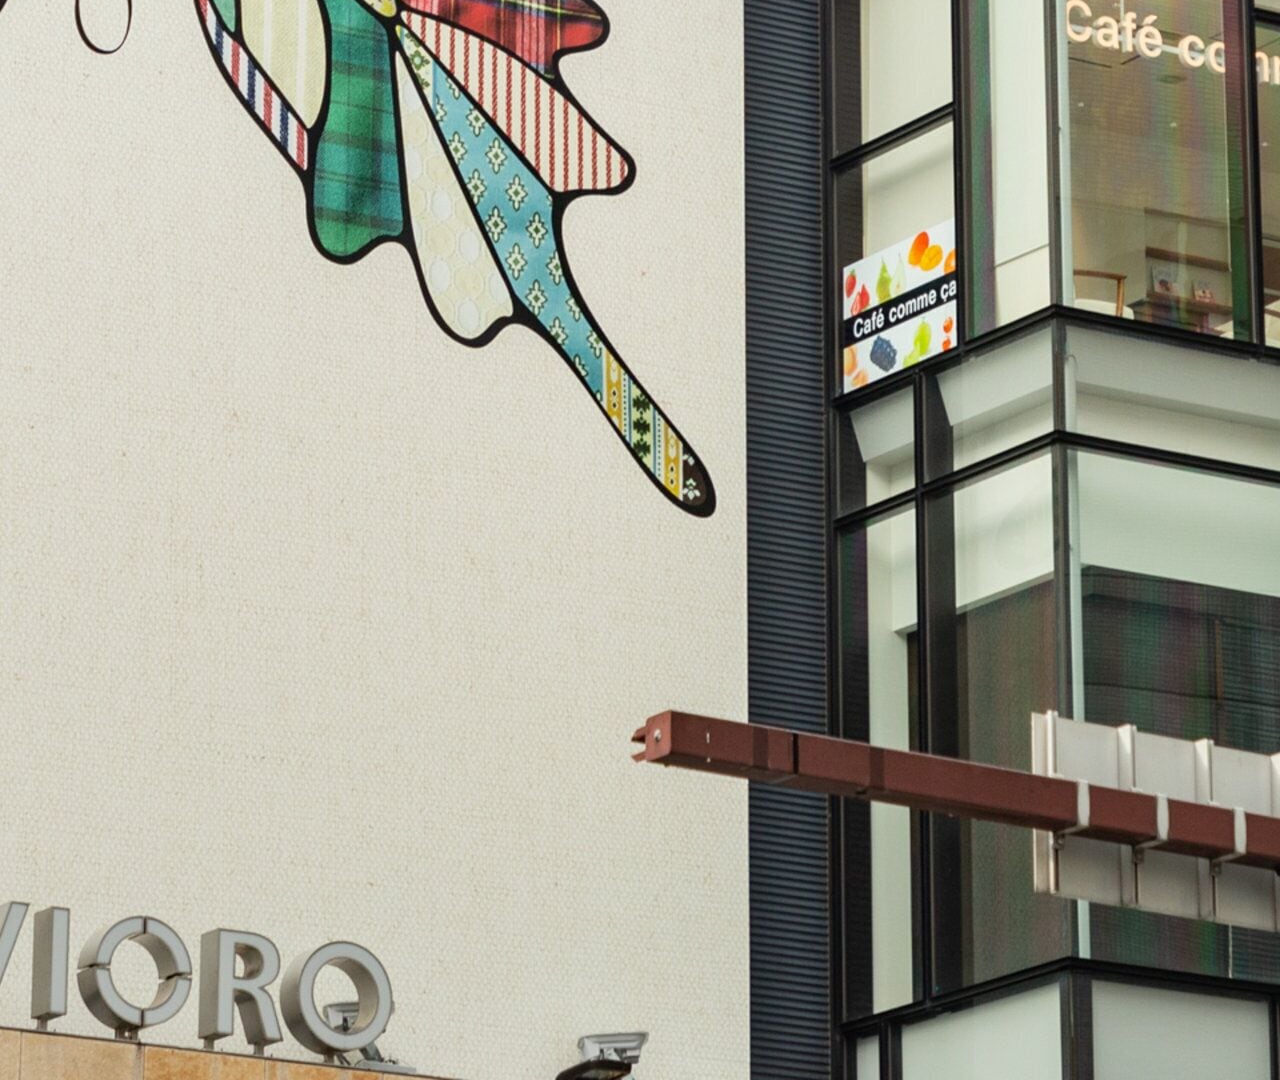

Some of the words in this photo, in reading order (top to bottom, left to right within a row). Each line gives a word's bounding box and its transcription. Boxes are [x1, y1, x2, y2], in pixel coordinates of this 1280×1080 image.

[1066, 0, 1163, 58] Café
[853, 308, 884, 338] Café
[888, 289, 937, 323] comme
[940, 280, 957, 302] ça
